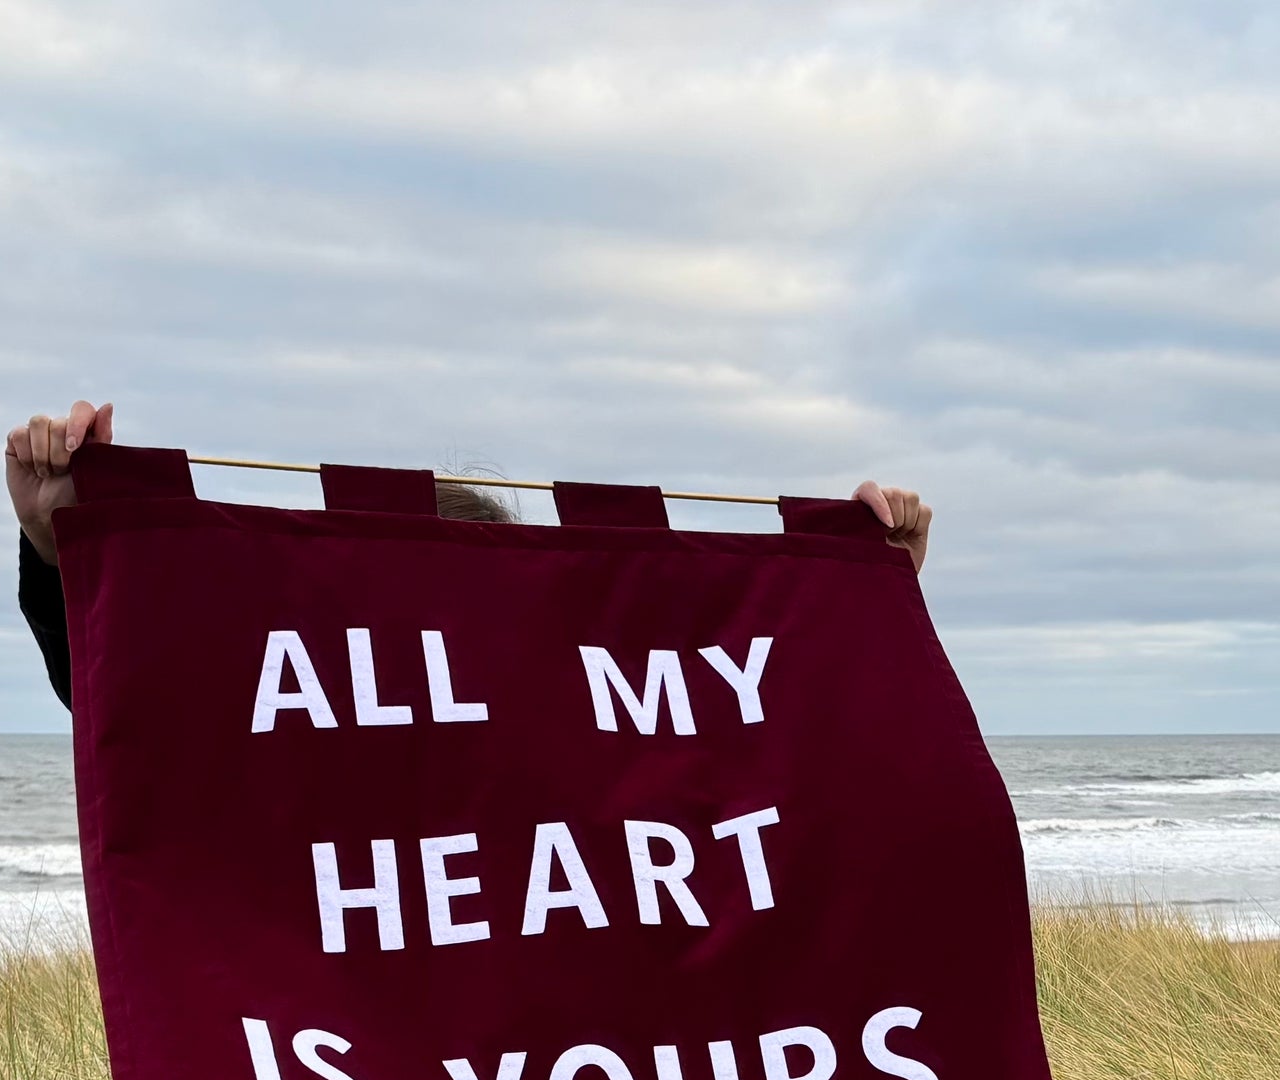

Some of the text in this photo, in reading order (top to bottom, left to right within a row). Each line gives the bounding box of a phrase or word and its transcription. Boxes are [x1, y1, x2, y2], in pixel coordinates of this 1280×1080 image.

[252, 628, 774, 736] ALL MY
[312, 807, 781, 953] HEART
